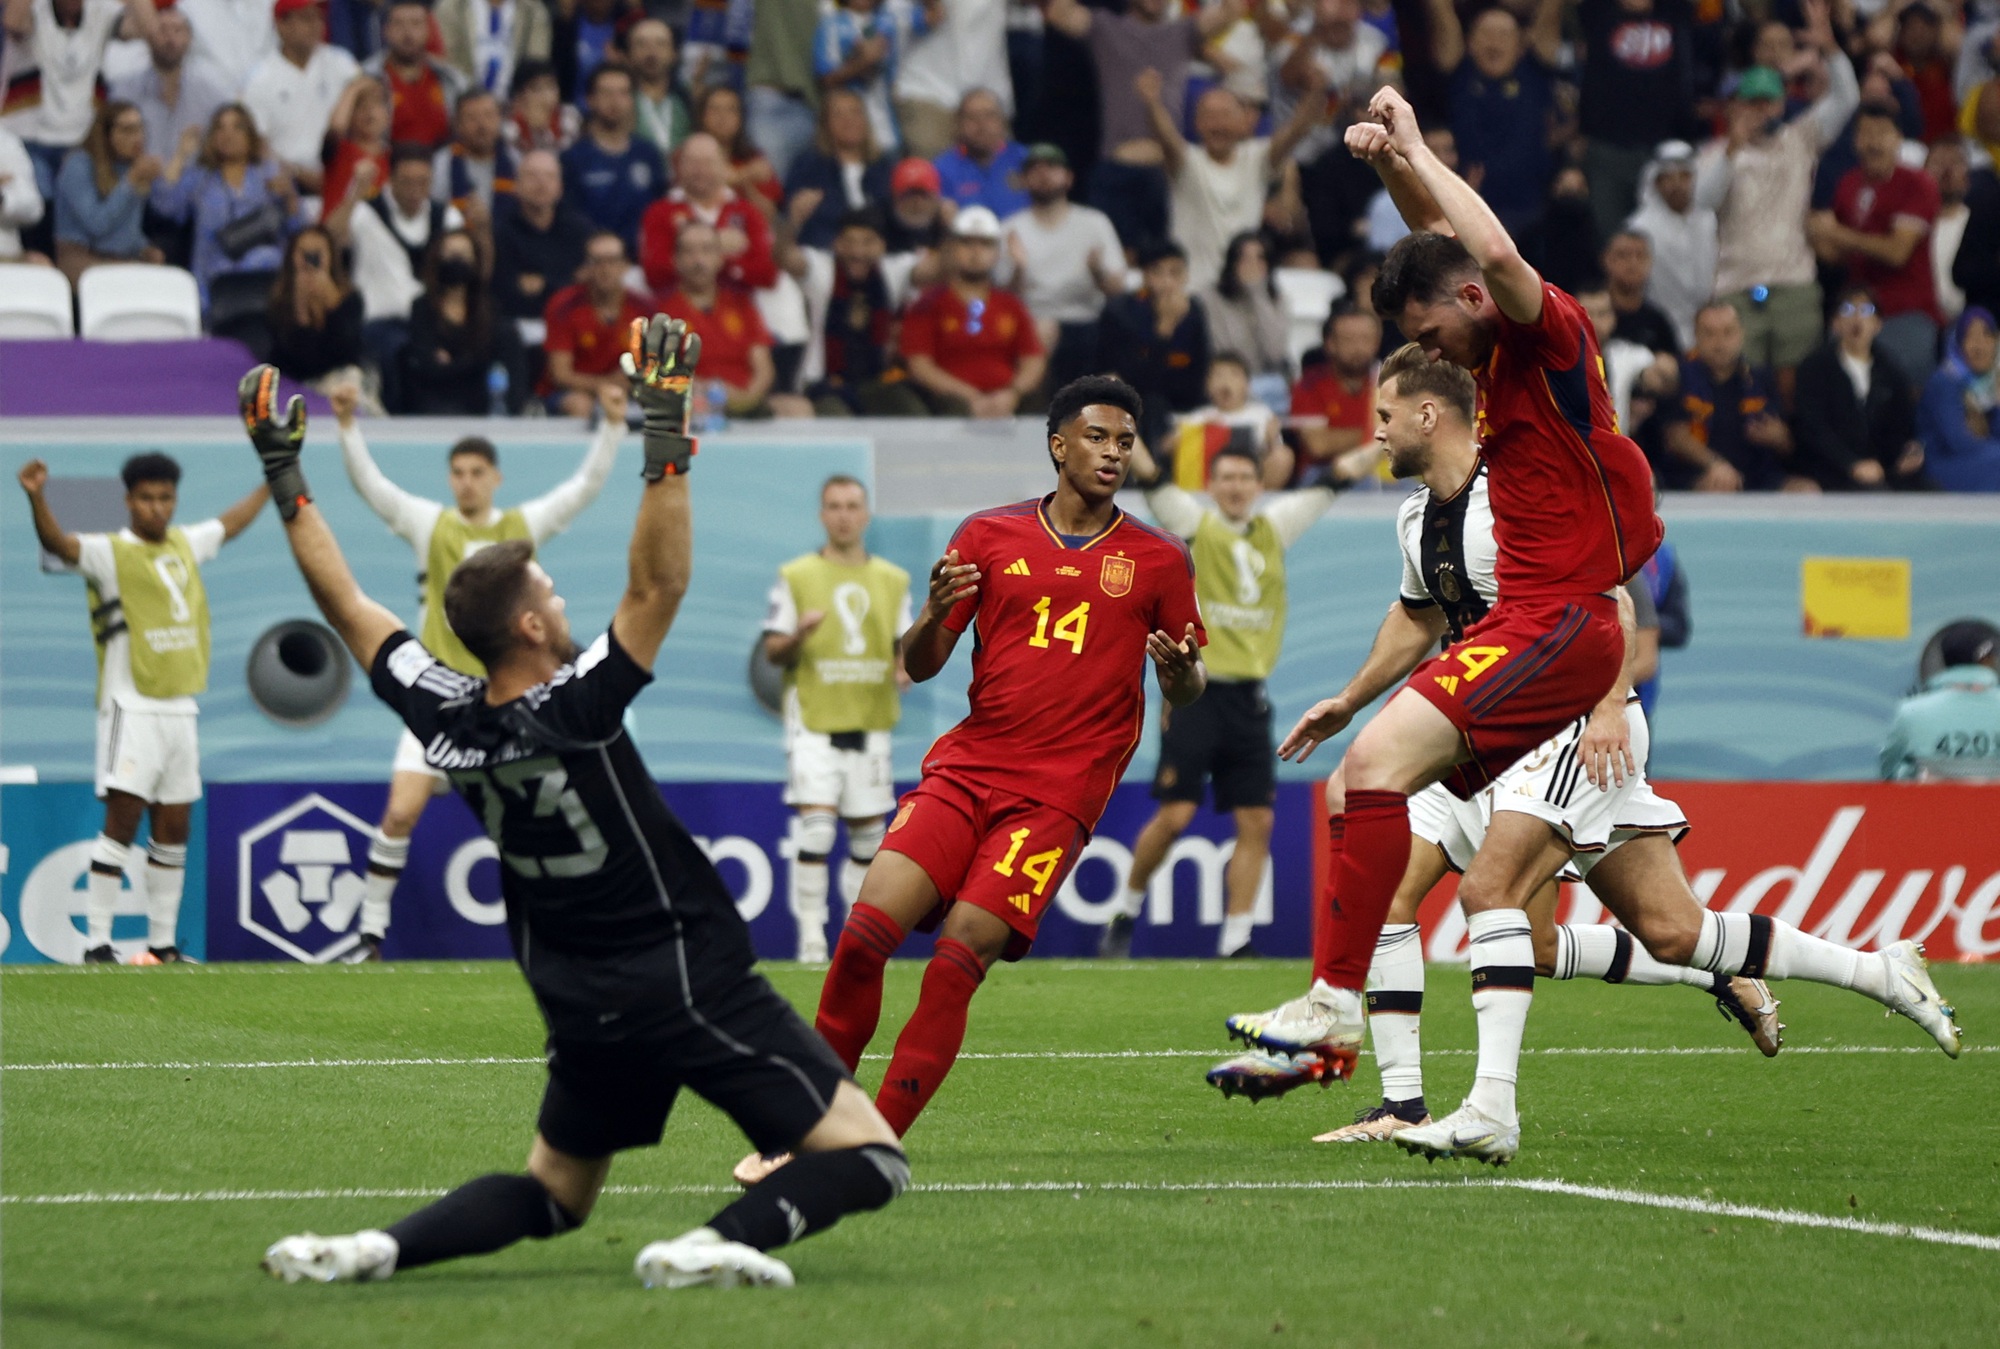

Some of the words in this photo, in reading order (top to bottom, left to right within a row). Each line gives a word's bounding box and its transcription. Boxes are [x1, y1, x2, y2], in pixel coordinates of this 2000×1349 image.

[1029, 595, 1090, 654] 14
[1439, 637, 1509, 682] 4
[1934, 728, 2000, 758] 420
[993, 827, 1064, 896] 14
